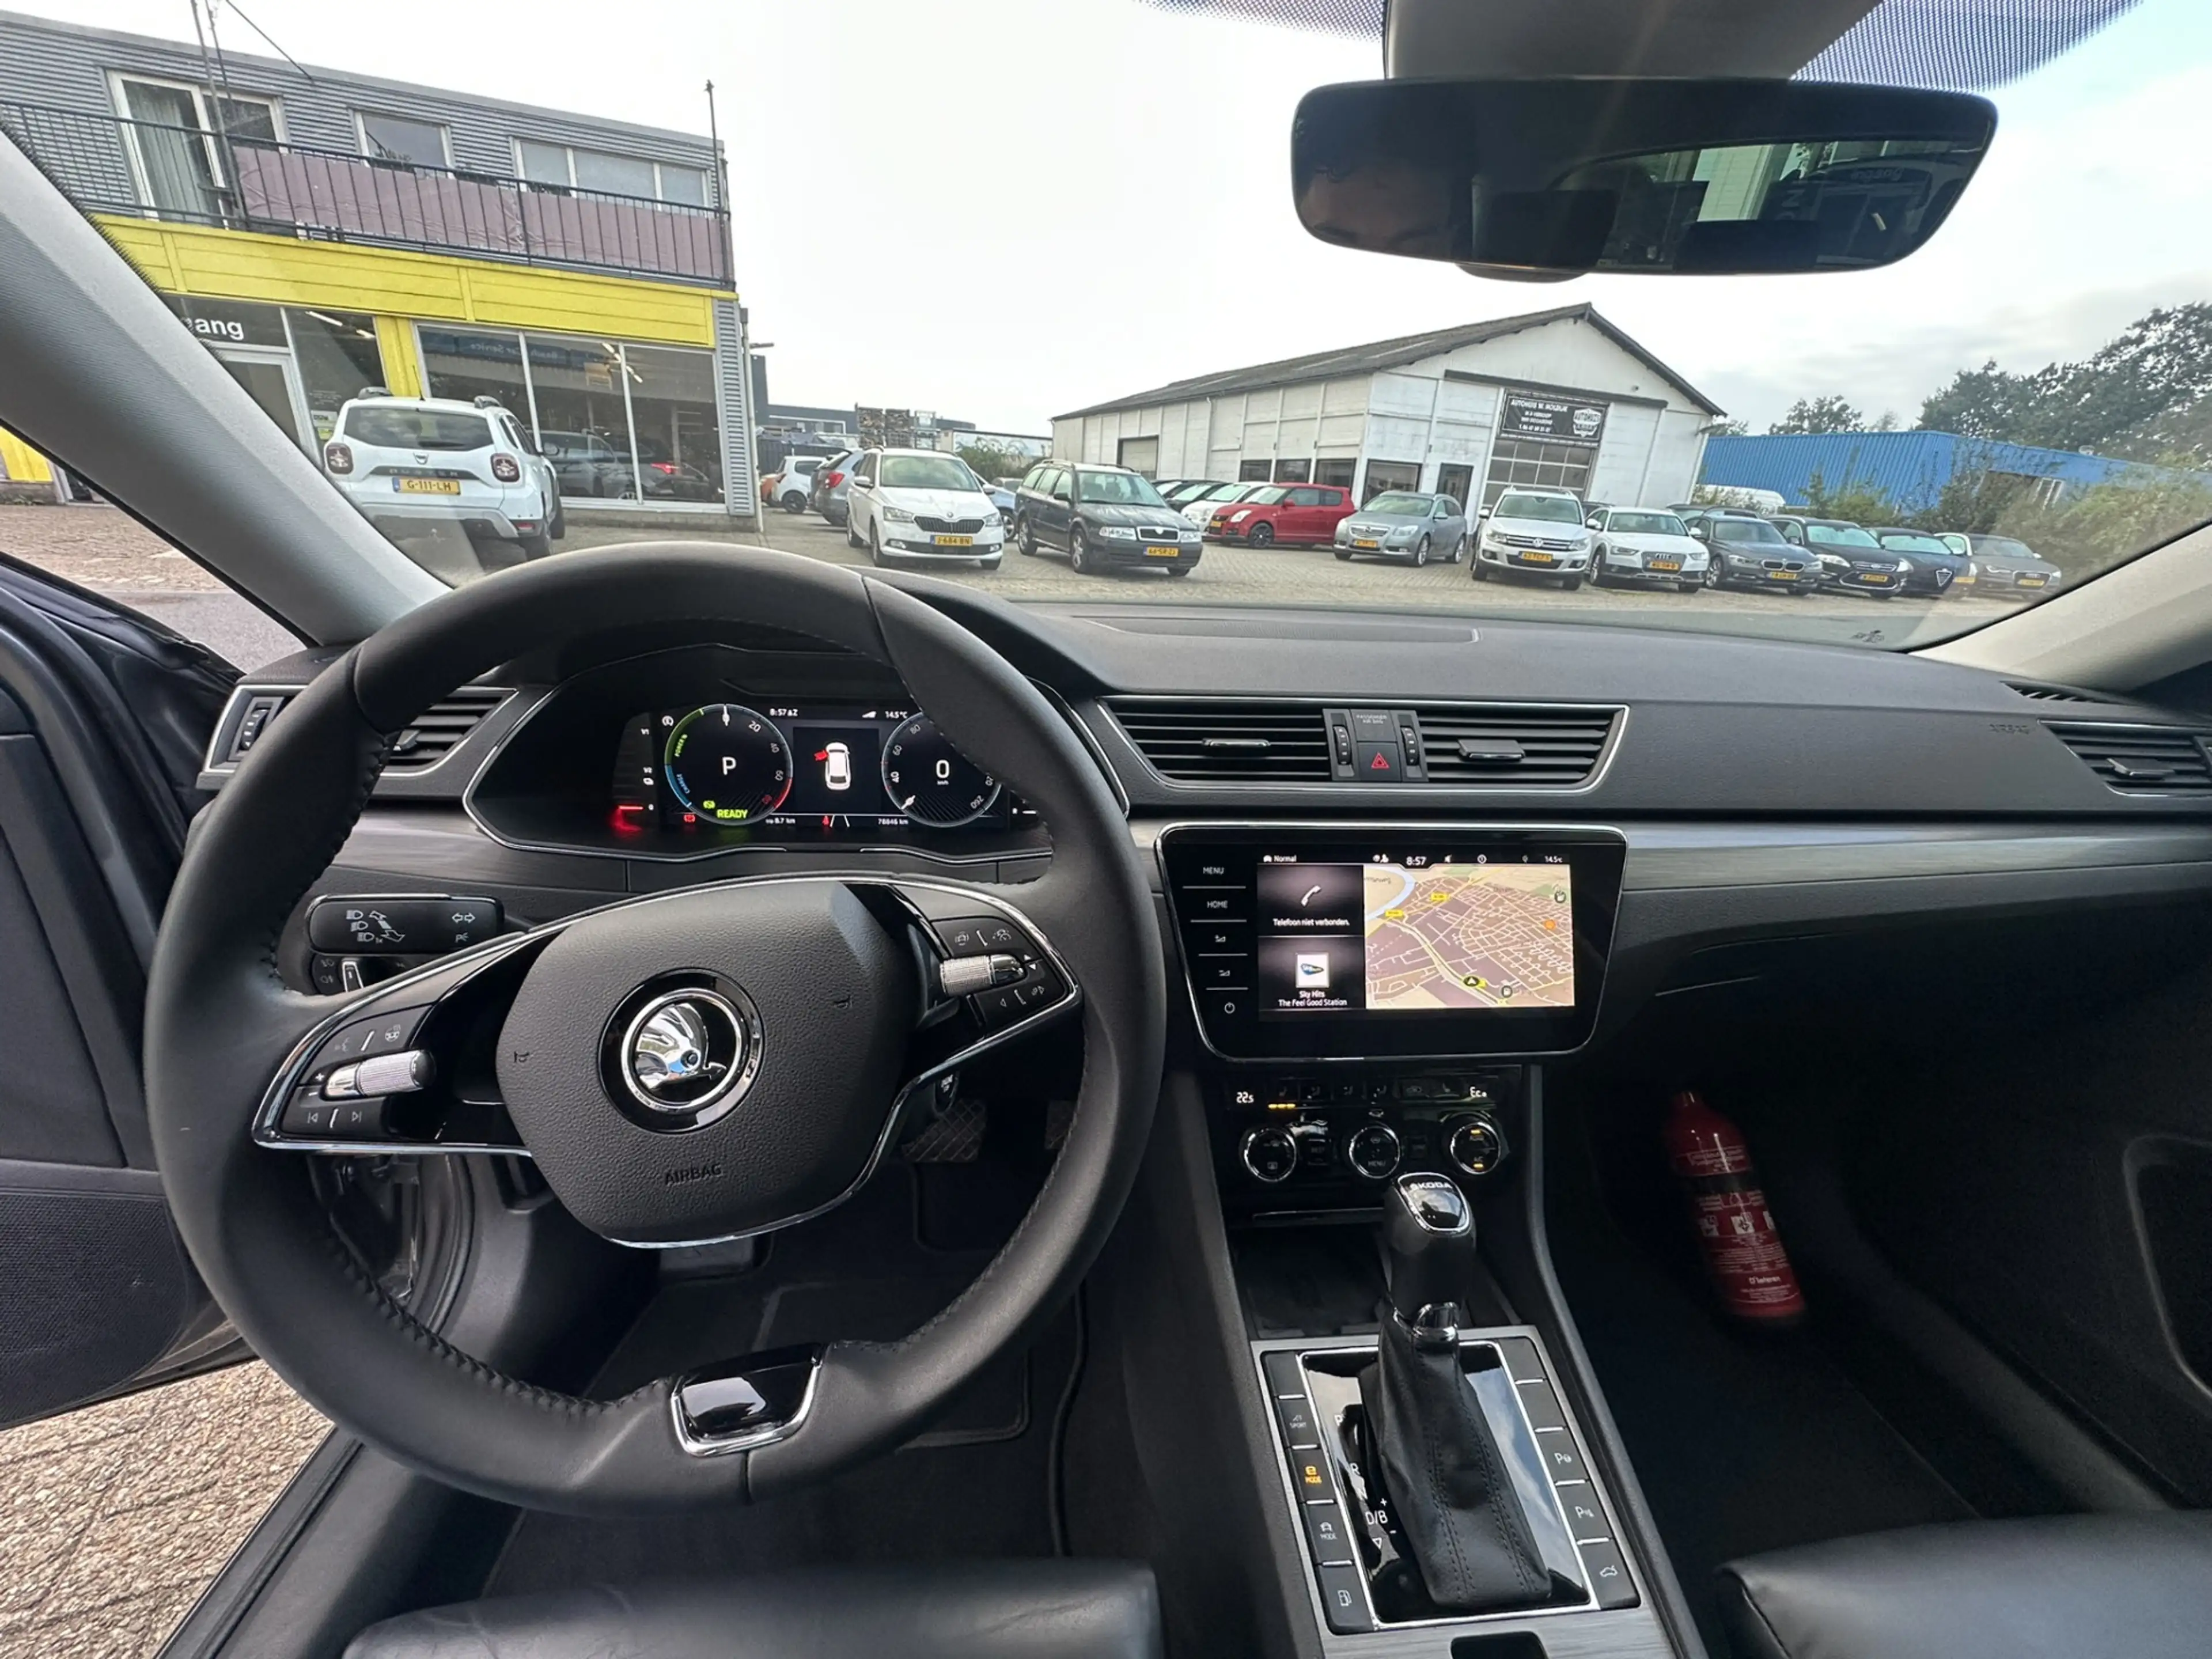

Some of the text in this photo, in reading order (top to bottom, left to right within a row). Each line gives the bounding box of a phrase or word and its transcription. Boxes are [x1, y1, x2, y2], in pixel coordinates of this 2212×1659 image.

[406, 480, 452, 491] G-111-LH
[748, 720, 762, 733] 20
[722, 756, 737, 775] P
[935, 759, 950, 779] 0
[890, 771, 900, 783] 40
[716, 809, 749, 819] READY
[1406, 856, 1427, 865] 8:57
[1202, 866, 1225, 874] MENU
[1207, 900, 1229, 909] HOME
[1273, 918, 1301, 926] Telefoon
[1301, 918, 1315, 926] niet
[1298, 990, 1325, 999] Sky Hits
[1278, 998, 1348, 1007] The Feel Good Station
[665, 1164, 722, 1185] AIRBAG
[1350, 1463, 1360, 1475] R
[1305, 1475, 1323, 1484] MODE
[1365, 1510, 1388, 1525] D/B
